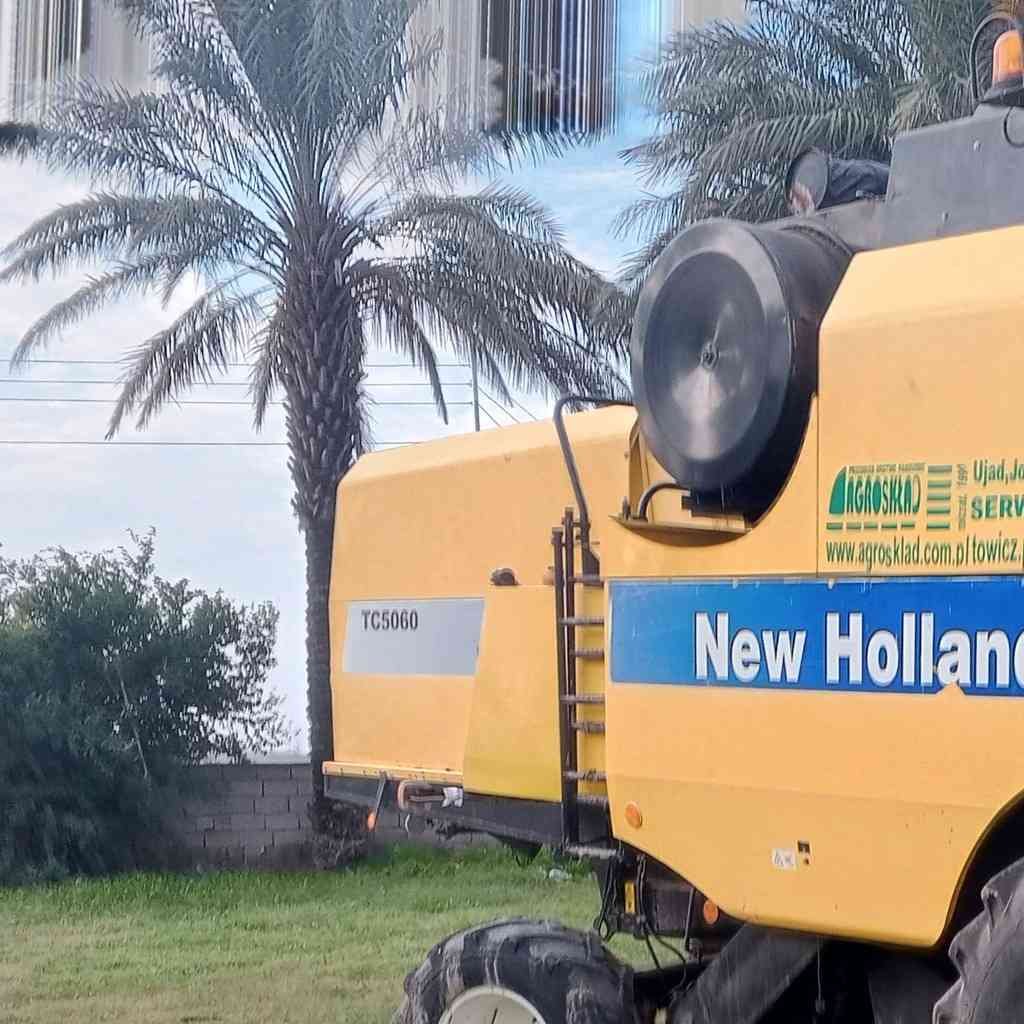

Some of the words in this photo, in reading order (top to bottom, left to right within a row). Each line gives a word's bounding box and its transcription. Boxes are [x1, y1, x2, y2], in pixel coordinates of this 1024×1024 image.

[826, 535, 969, 570] www.agrosklad.com.pl
[361, 608, 419, 631] TC5060
[694, 610, 807, 684] New
